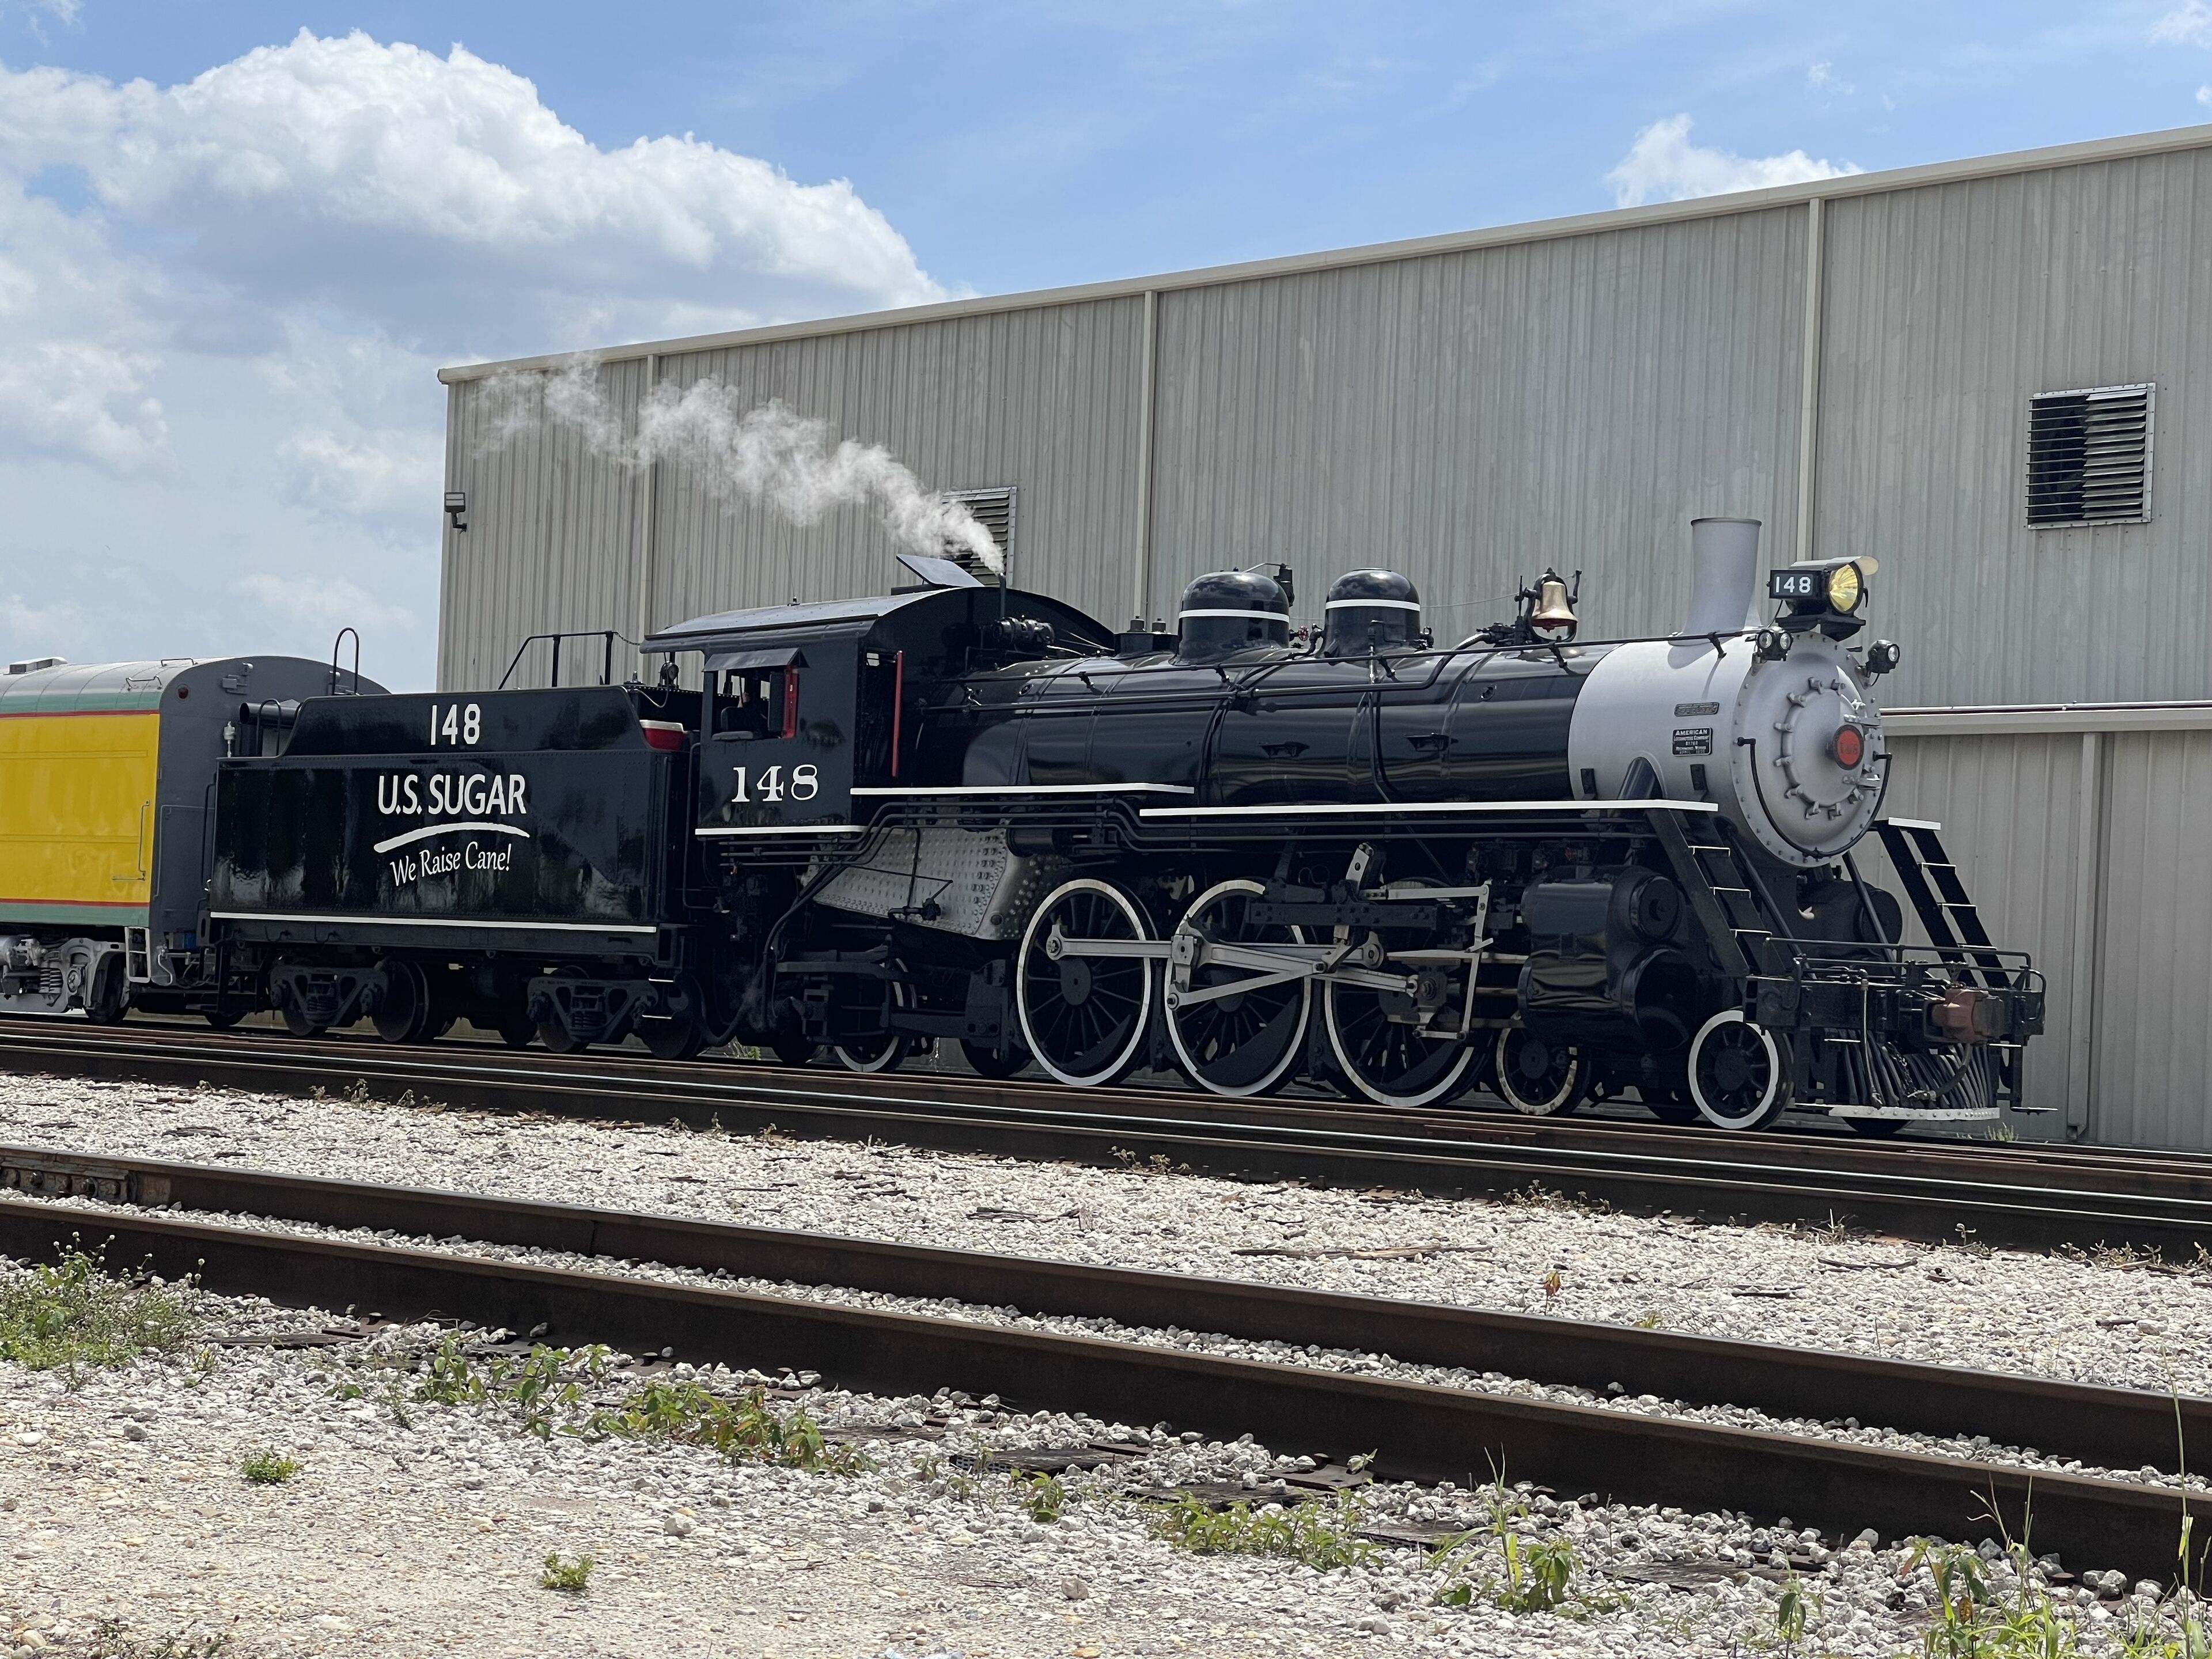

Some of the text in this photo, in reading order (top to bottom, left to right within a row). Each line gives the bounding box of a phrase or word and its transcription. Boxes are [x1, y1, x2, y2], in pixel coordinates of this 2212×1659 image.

[1775, 576, 1811, 593] 148
[430, 703, 480, 745] 148
[378, 774, 527, 815] U.S. SUGAR
[731, 764, 819, 802] 148
[389, 840, 512, 887] We Raise Cane!
